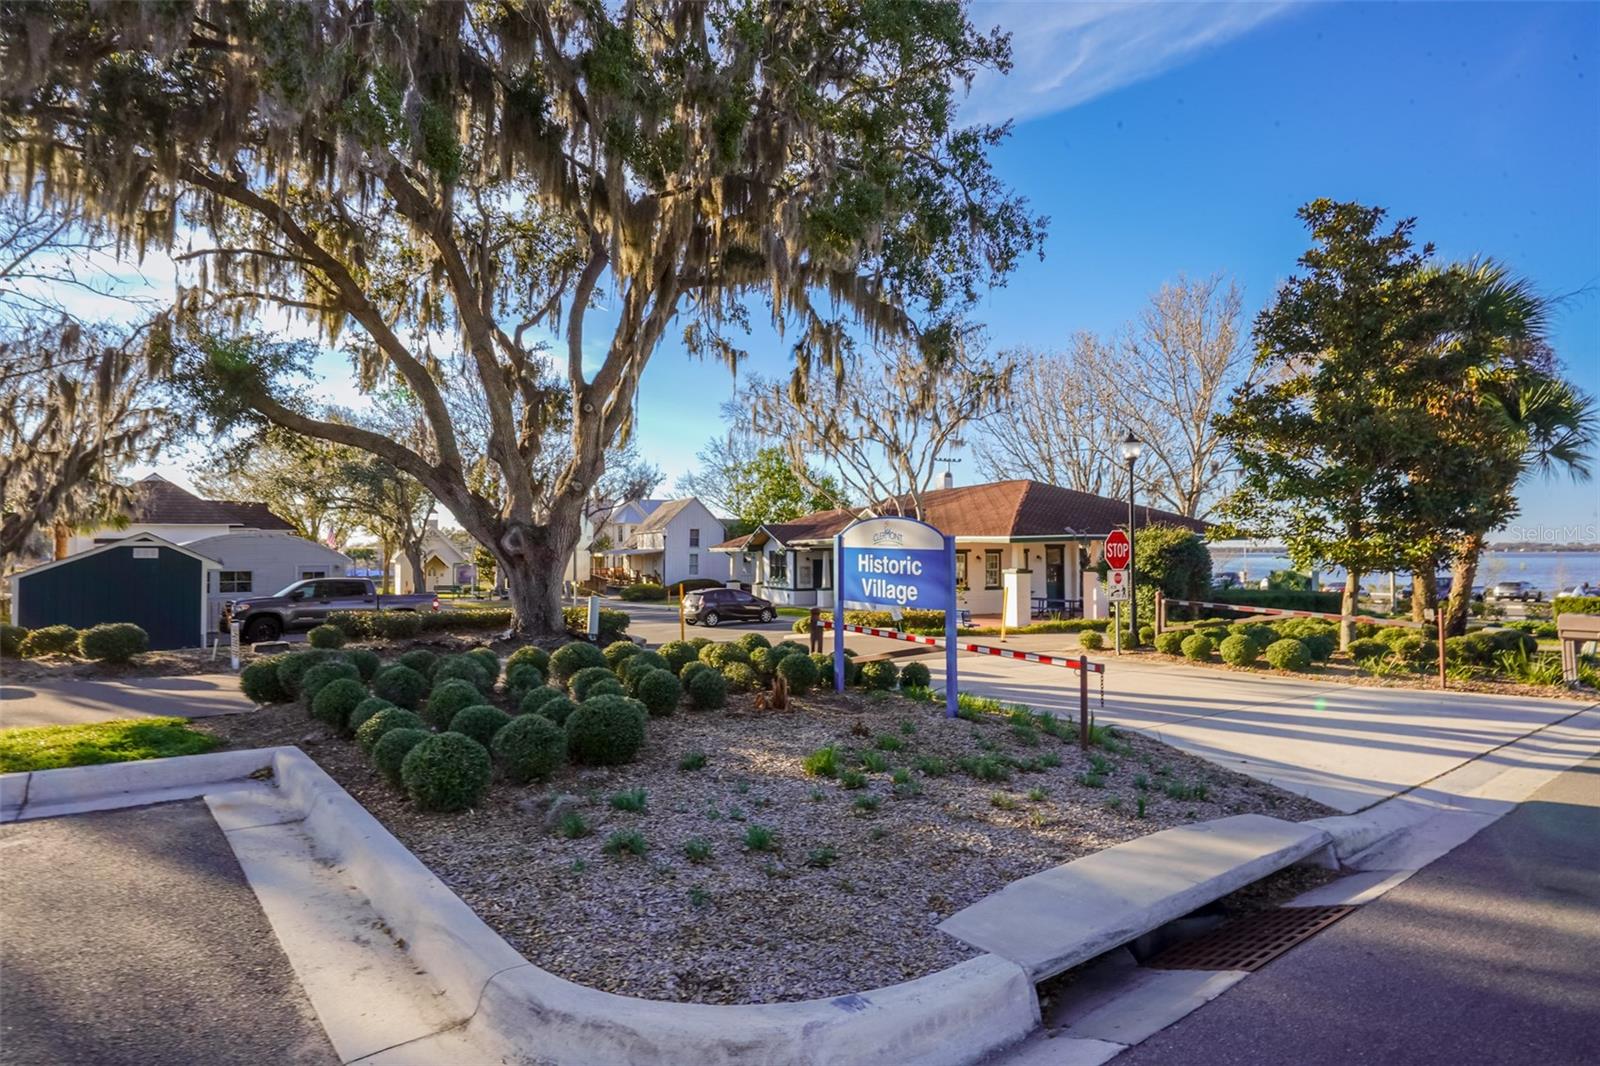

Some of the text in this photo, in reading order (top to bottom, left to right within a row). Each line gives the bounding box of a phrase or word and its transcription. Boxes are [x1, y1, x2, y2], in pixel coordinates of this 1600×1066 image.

[1107, 543, 1129, 558] STOP
[857, 553, 922, 576] Historic
[861, 577, 918, 605] Village
